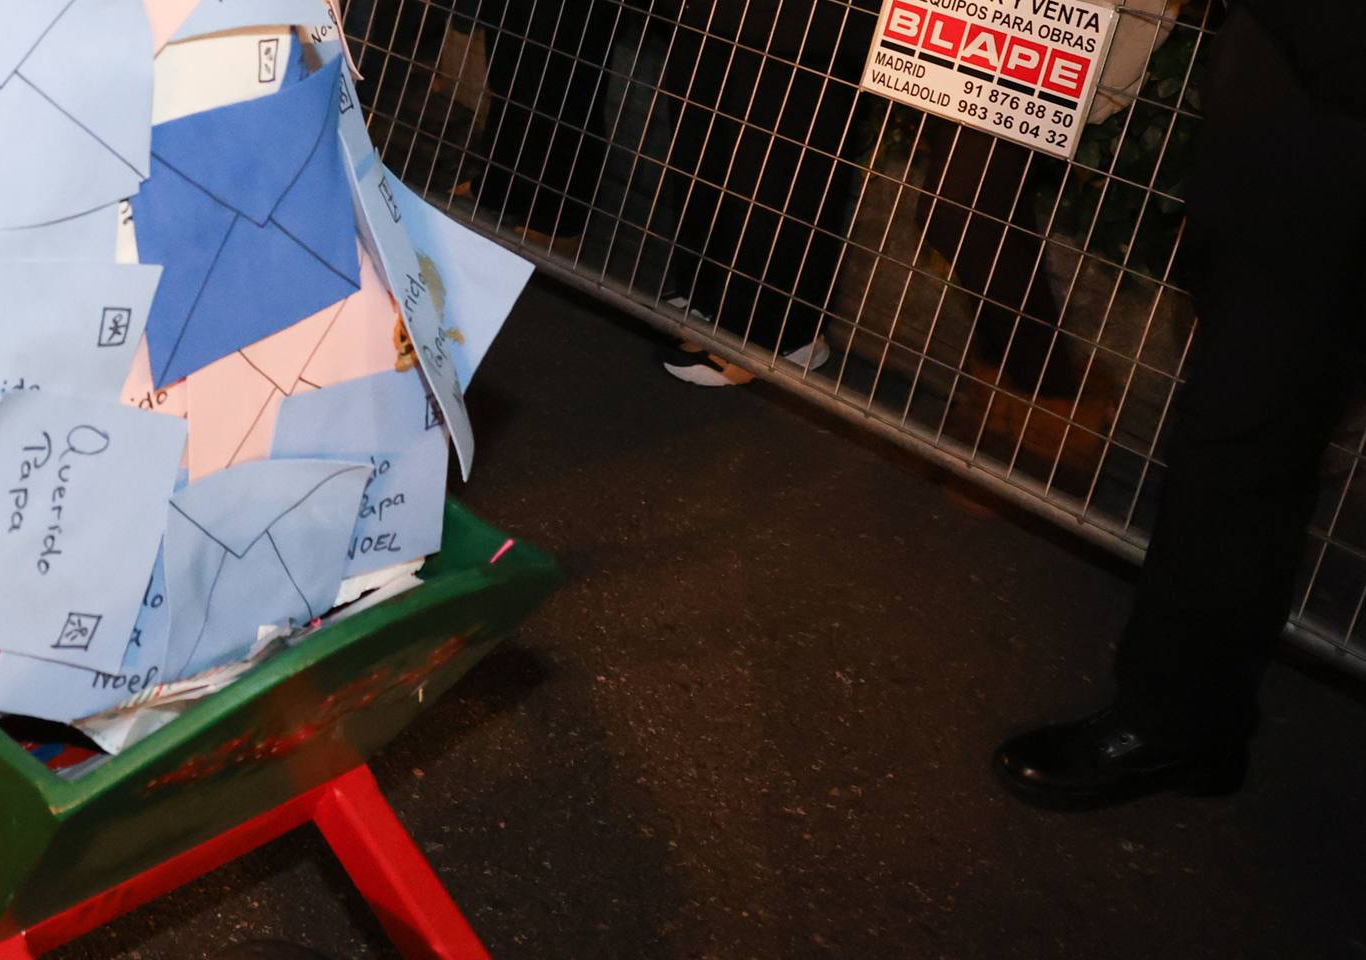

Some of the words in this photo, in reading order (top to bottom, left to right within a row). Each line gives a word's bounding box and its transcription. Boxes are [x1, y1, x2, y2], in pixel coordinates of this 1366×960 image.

[887, 7, 1083, 90] BLAPE
[991, 12, 1034, 35] PARA
[1038, 24, 1097, 53] OBRAS
[871, 69, 951, 107] VALLADOLID
[958, 100, 988, 121] 983
[993, 112, 1013, 129] 36
[1019, 121, 1041, 138] 04
[1045, 130, 1068, 148] 32
[875, 52, 926, 79] MADRID
[963, 81, 982, 98] 91
[989, 89, 1020, 110] 876
[1024, 101, 1046, 119] 88
[1051, 109, 1074, 128] 50
[9, 431, 52, 533] Papa
[37, 424, 110, 575] Querido
